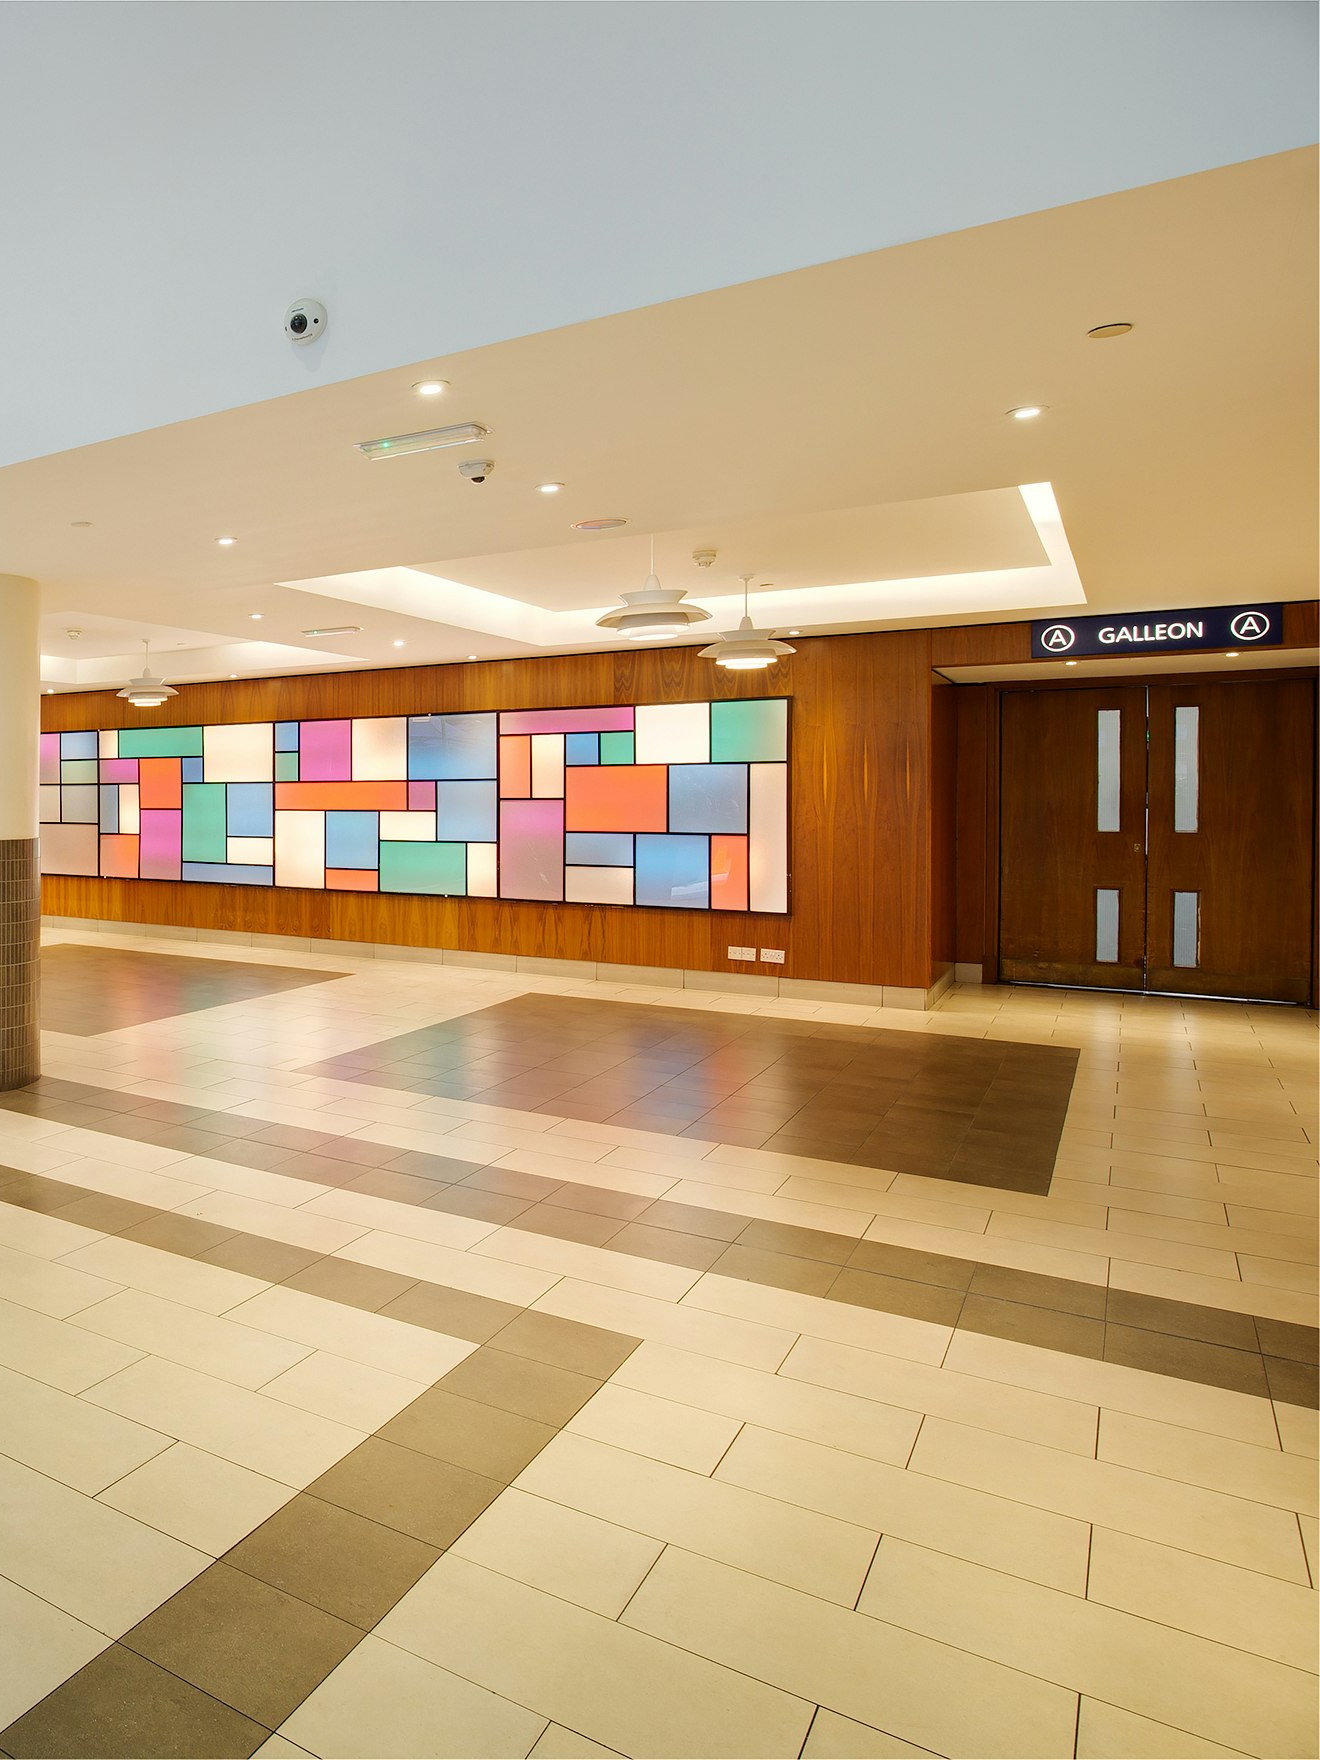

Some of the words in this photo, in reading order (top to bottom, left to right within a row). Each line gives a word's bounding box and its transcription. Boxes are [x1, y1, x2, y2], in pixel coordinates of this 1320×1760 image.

[1048, 629, 1068, 647] A
[1098, 621, 1204, 645] GALLEON
[1239, 616, 1262, 636] A
